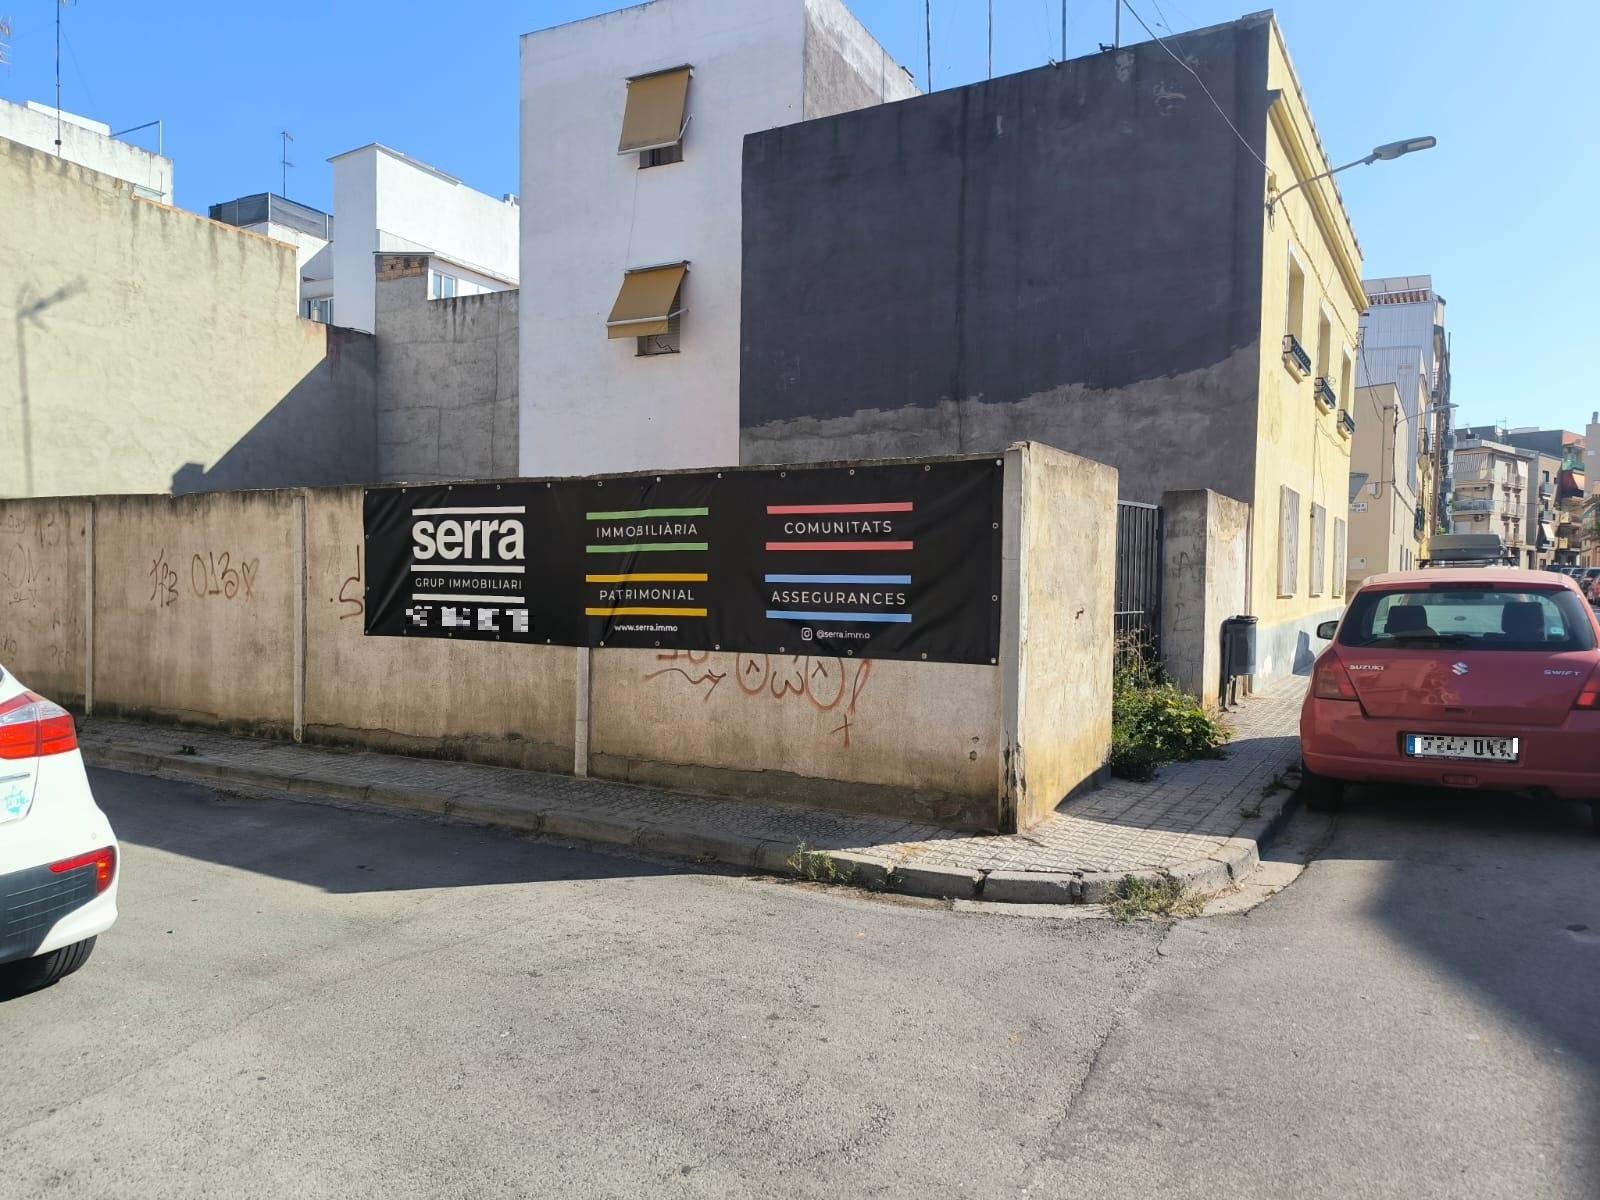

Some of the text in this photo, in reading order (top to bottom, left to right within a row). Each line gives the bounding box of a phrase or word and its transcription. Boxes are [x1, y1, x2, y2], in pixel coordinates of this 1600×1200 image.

[596, 521, 698, 538] IMMOBILIÀRIA
[784, 520, 892, 535] COMUNITATS
[411, 519, 526, 561] serra
[415, 577, 522, 590] GRUP IMMOBILIARI
[599, 588, 695, 601] PATRIMONIAL
[771, 590, 906, 605] ASSEGURANCES
[613, 624, 679, 632] www.serra.immo
[816, 629, 871, 640] @serra.immo
